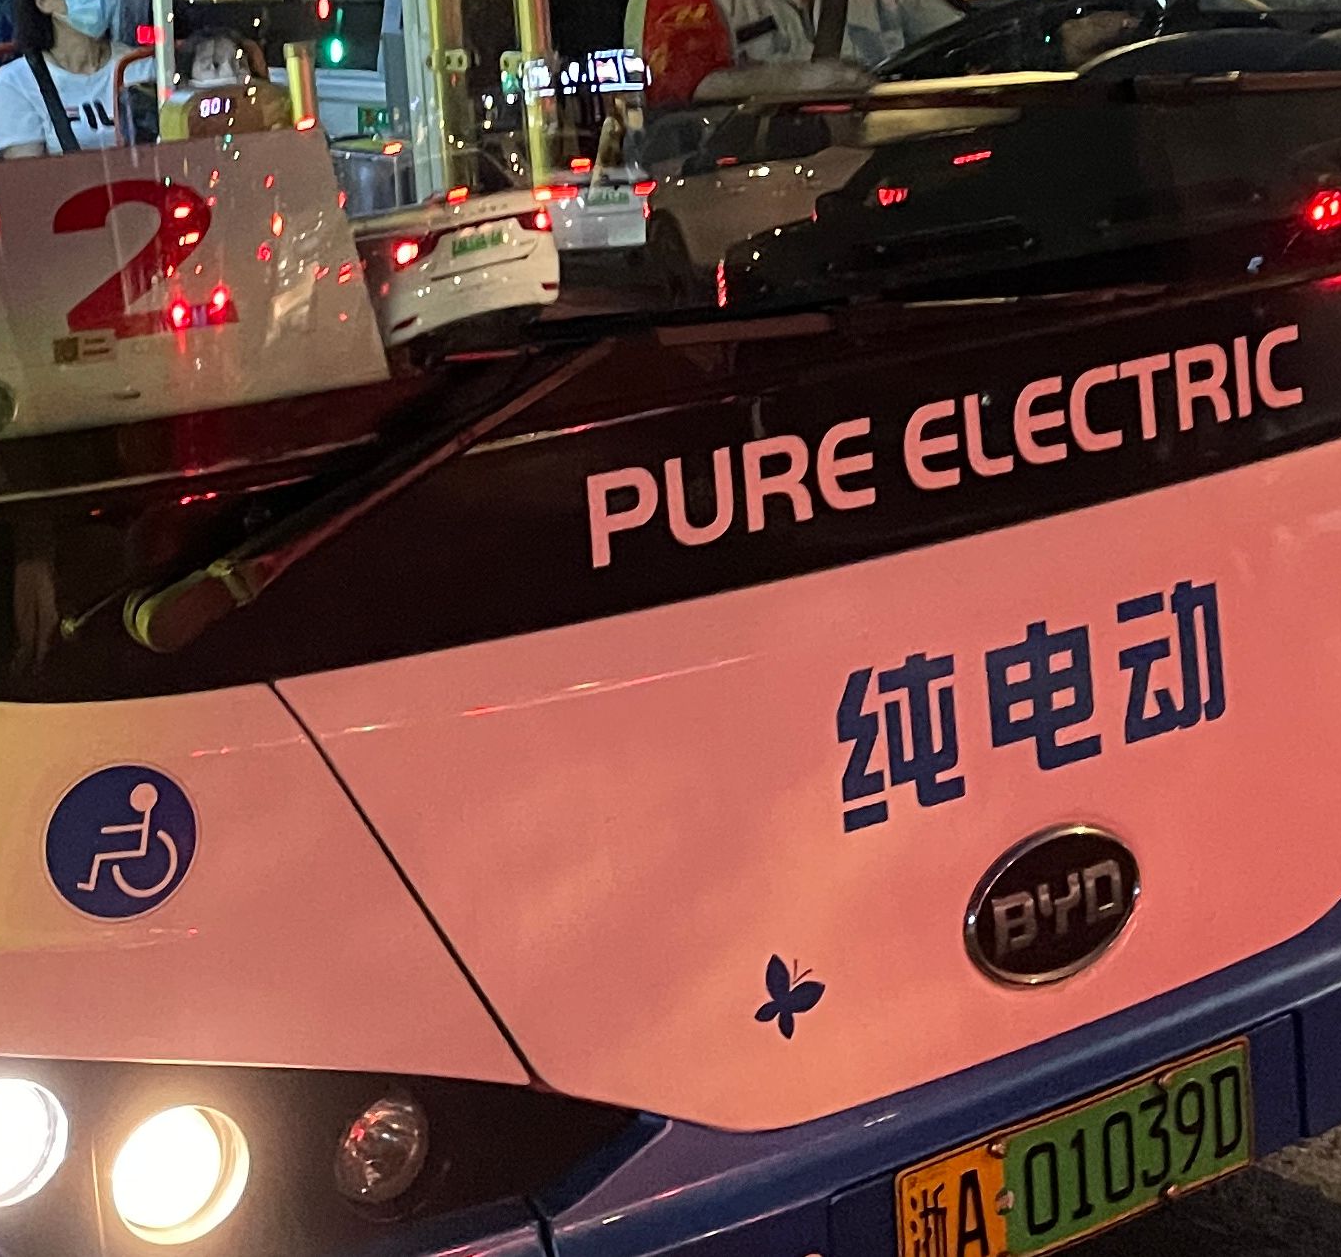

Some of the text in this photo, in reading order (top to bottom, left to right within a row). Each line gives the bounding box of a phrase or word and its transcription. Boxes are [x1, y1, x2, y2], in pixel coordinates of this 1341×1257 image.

[53, 180, 239, 339] 2
[587, 324, 1304, 569] PURE ELECTRIC
[836, 579, 1228, 833] 纯电动
[993, 857, 1125, 958] BYD
[910, 1065, 1243, 1257] 浙A 01039D
